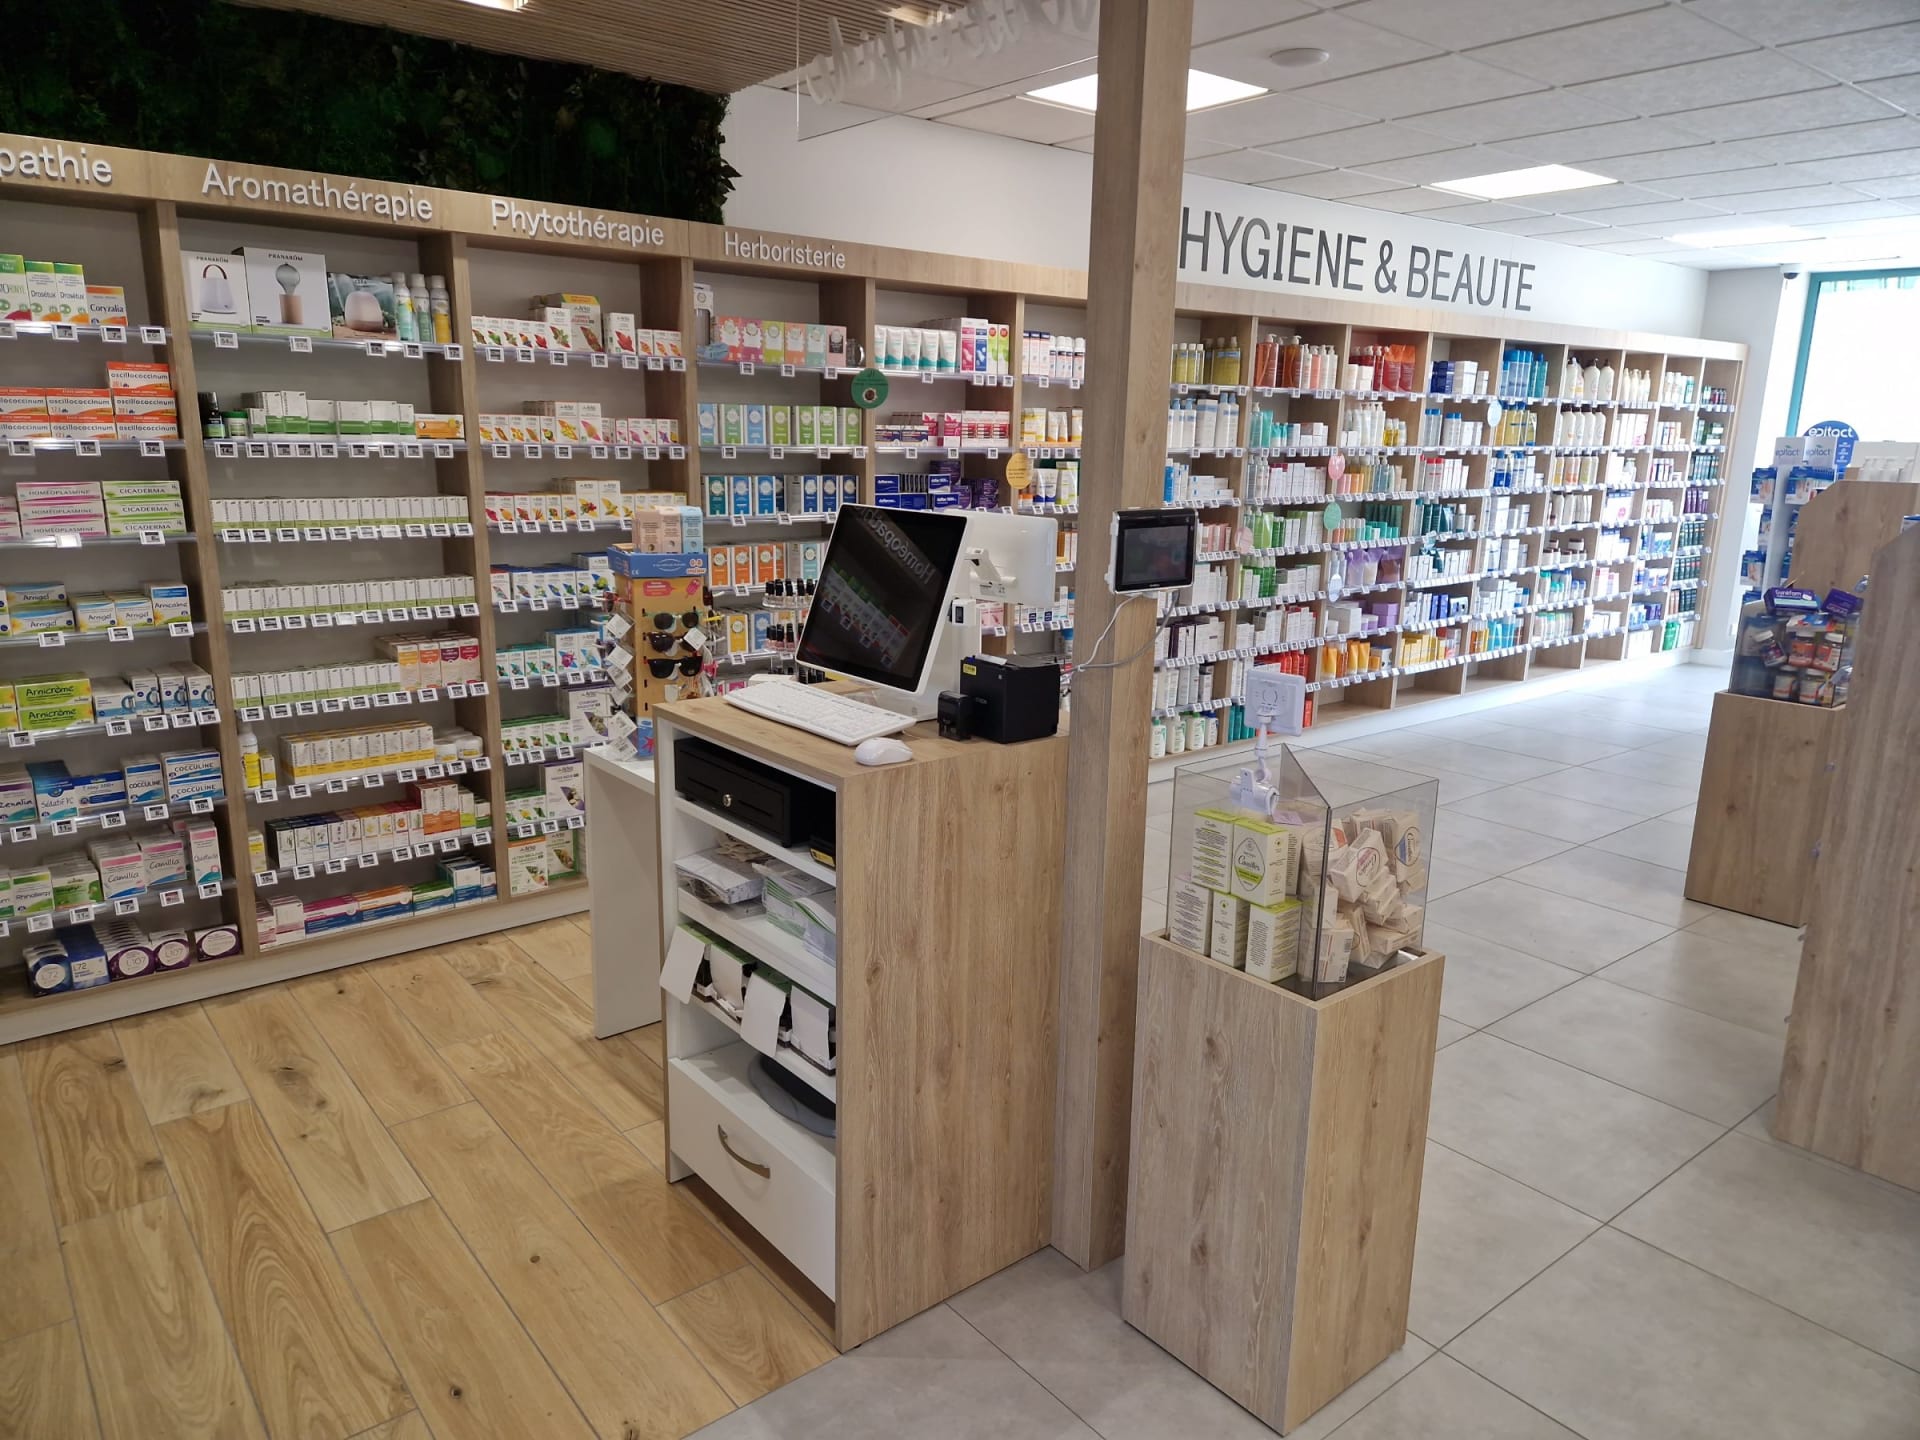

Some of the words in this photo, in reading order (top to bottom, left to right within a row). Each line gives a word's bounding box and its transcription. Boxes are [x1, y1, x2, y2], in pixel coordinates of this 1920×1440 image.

[201, 162, 433, 222] Aromathérapie
[491, 199, 664, 247] Phytothérapie
[724, 231, 846, 269] Herboristerie
[1179, 206, 1367, 292] HYGIENE
[1374, 239, 1398, 294] &
[1406, 245, 1536, 312] BEAUTE
[90, 303, 124, 313] Coryzalia
[110, 372, 168, 380] oscillococcinum
[1808, 426, 1854, 438] epitact
[125, 523, 171, 531] CICADERMA
[23, 593, 50, 602] Arnigel
[88, 613, 113, 621] Arnigel
[125, 612, 149, 620] Arnigel
[30, 619, 57, 629] Arnigel
[26, 685, 74, 698] Arnicrème
[28, 708, 76, 720] Arnicrème
[174, 763, 214, 772] COCCULINE
[129, 780, 161, 789] COCCULINE
[177, 784, 216, 794] COCCULINE
